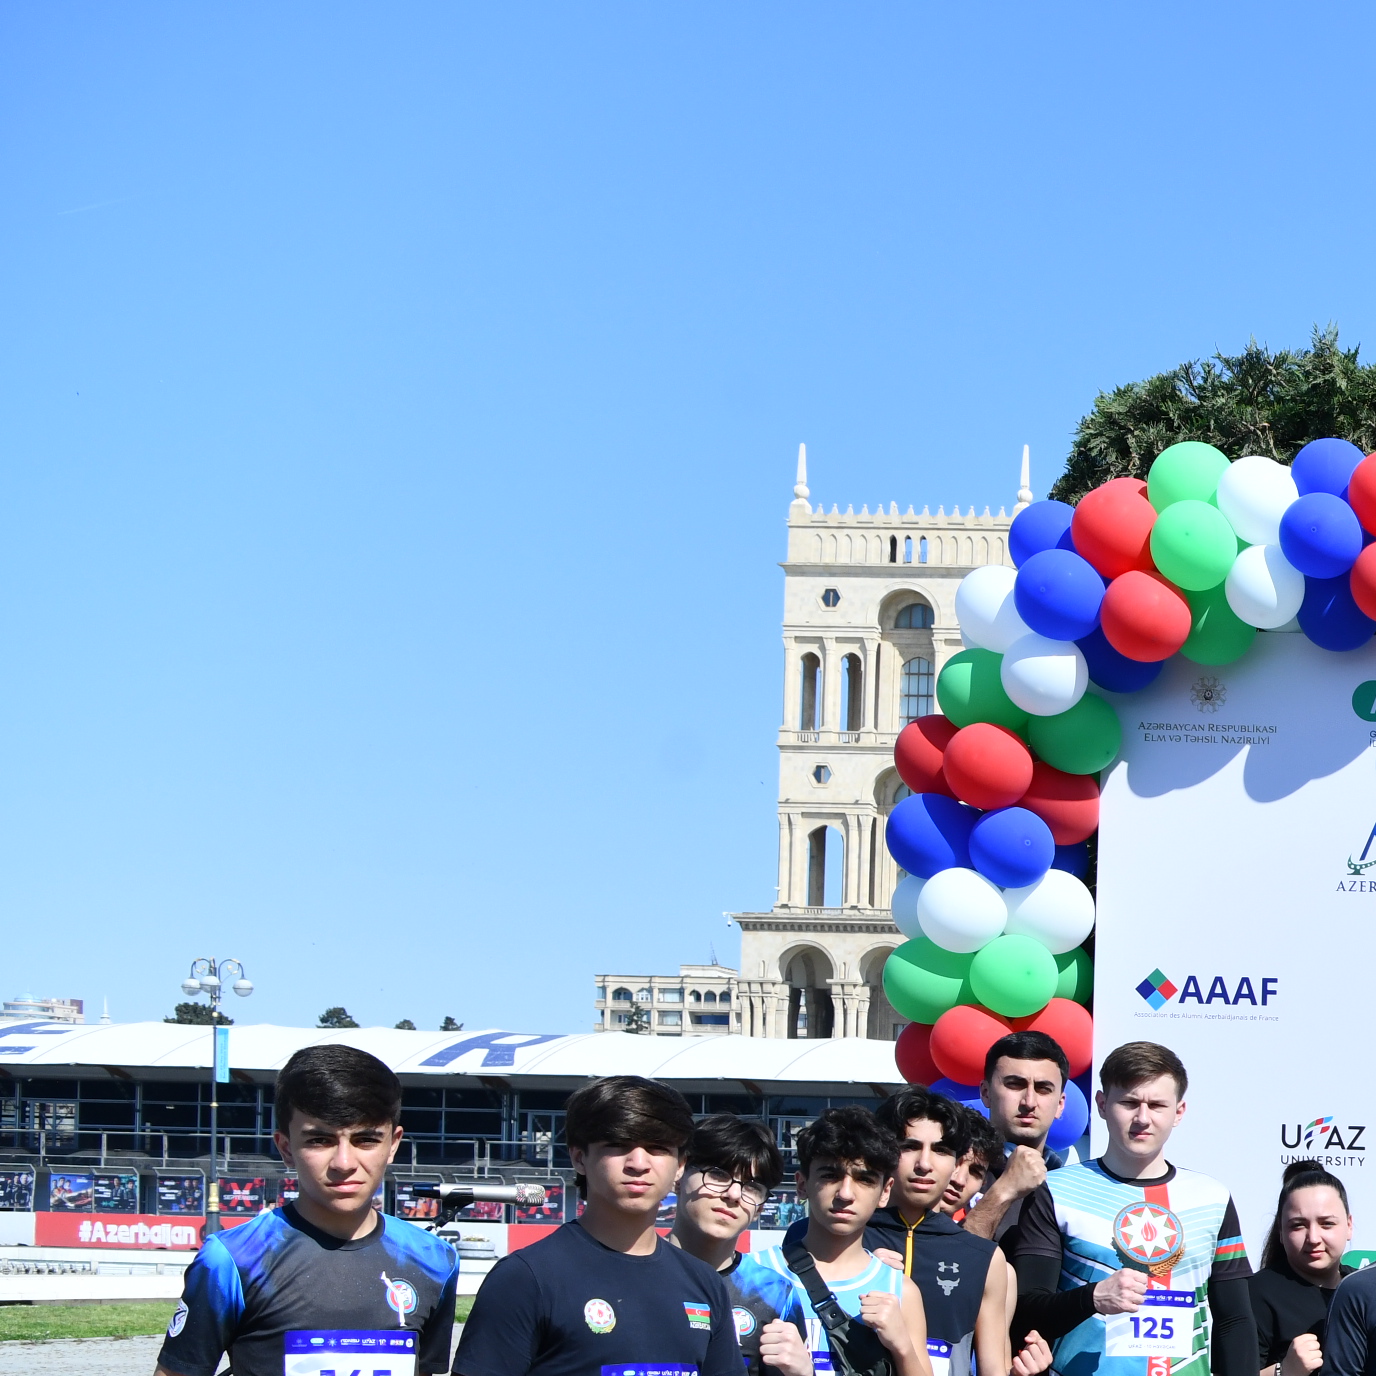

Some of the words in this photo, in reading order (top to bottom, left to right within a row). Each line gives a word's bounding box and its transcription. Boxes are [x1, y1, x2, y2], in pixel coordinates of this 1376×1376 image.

[1178, 975, 1279, 1006] AAAF
[1281, 1116, 1367, 1150] UFAZ
[79, 1220, 197, 1247] #Azerbaijan
[1129, 1316, 1174, 1339] 125
